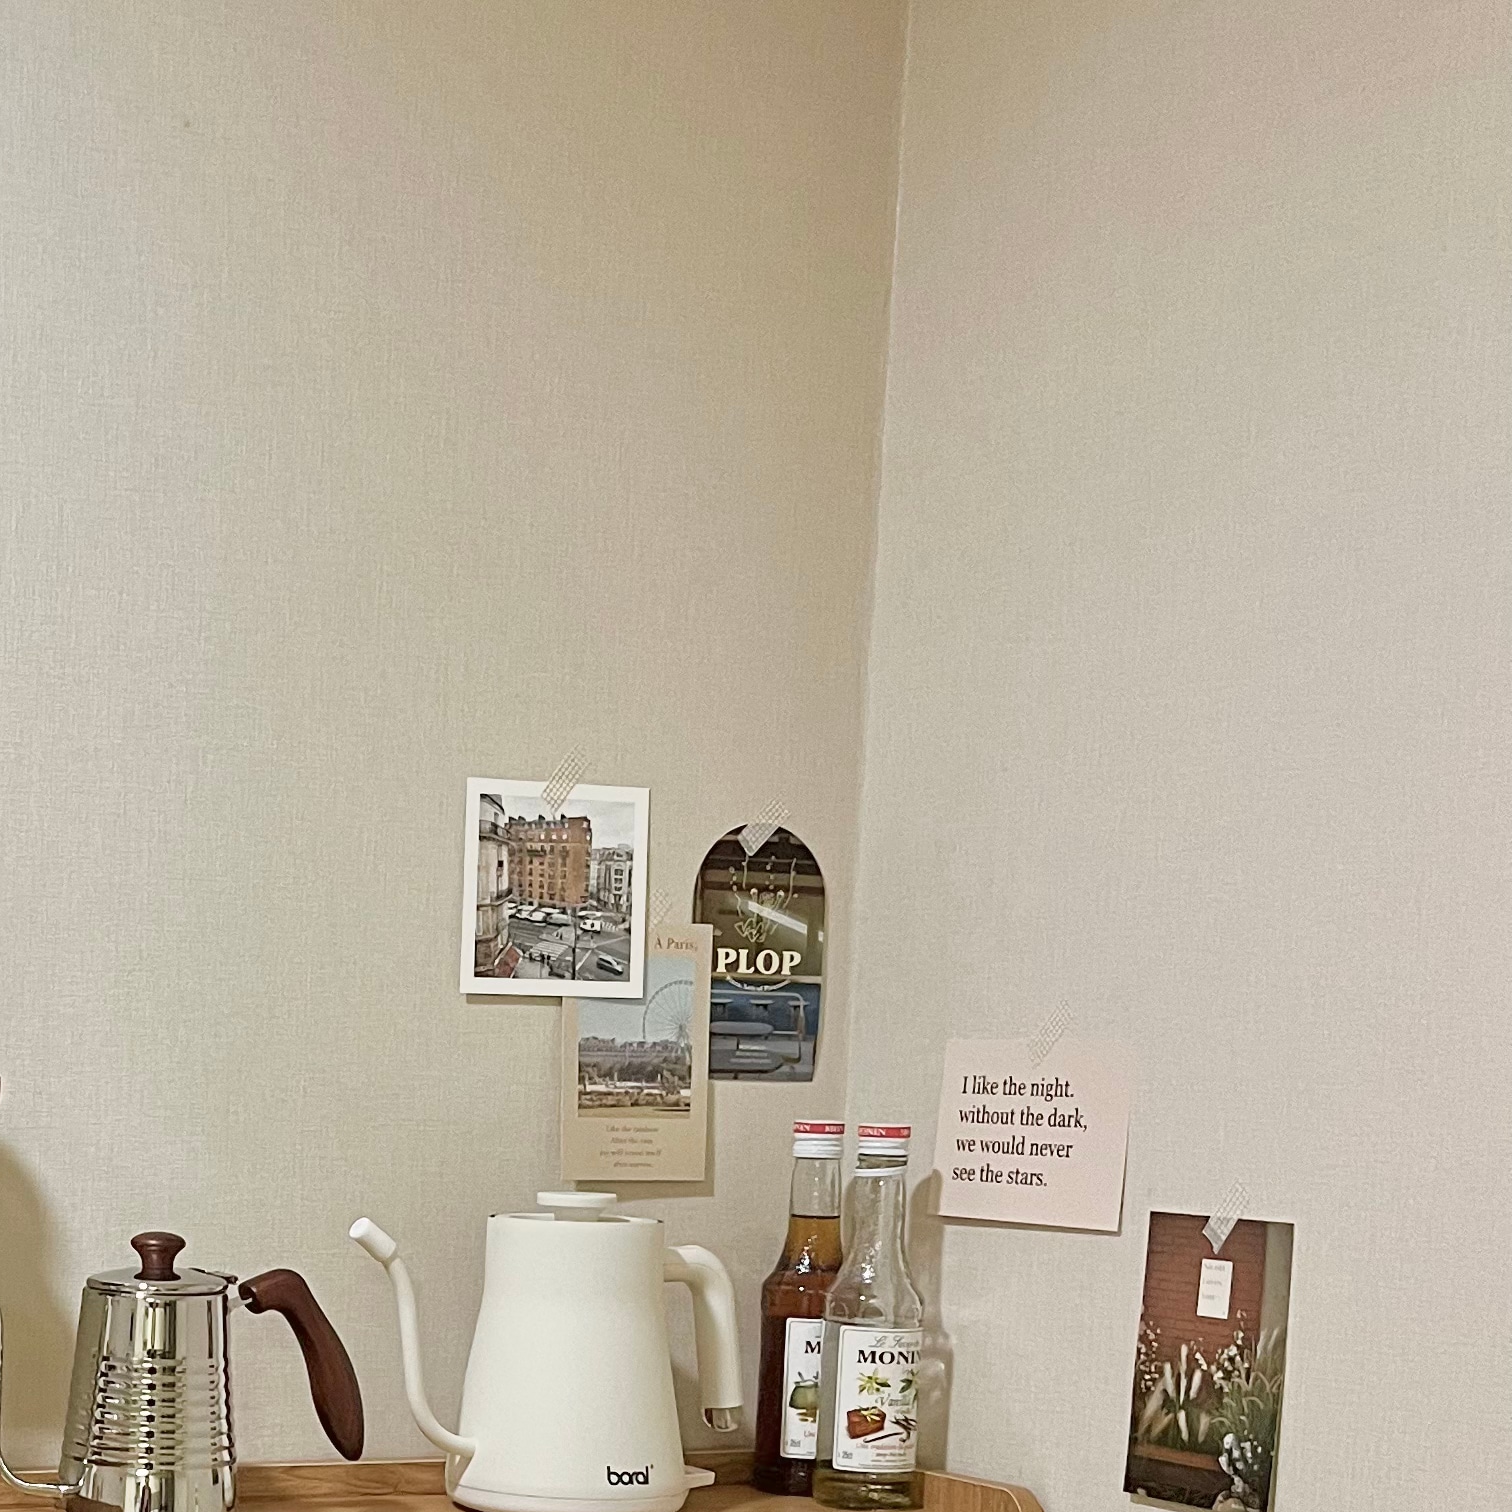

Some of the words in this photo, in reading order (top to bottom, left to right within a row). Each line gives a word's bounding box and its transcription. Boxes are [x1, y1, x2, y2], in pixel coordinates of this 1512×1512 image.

[716, 948, 802, 975] PLOP
[962, 1076, 968, 1094] I
[972, 1075, 999, 1095] like
[1002, 1075, 1026, 1096] the
[1030, 1077, 1074, 1102] night.
[959, 1104, 1015, 1125] without
[1020, 1105, 1044, 1126] the
[1047, 1107, 1087, 1132] dark,
[956, 1138, 976, 1152] we
[980, 1135, 1025, 1155] would
[1029, 1142, 1073, 1158] never
[952, 1166, 975, 1181] see
[979, 1163, 1003, 1183] the
[1006, 1168, 1047, 1187] stars.
